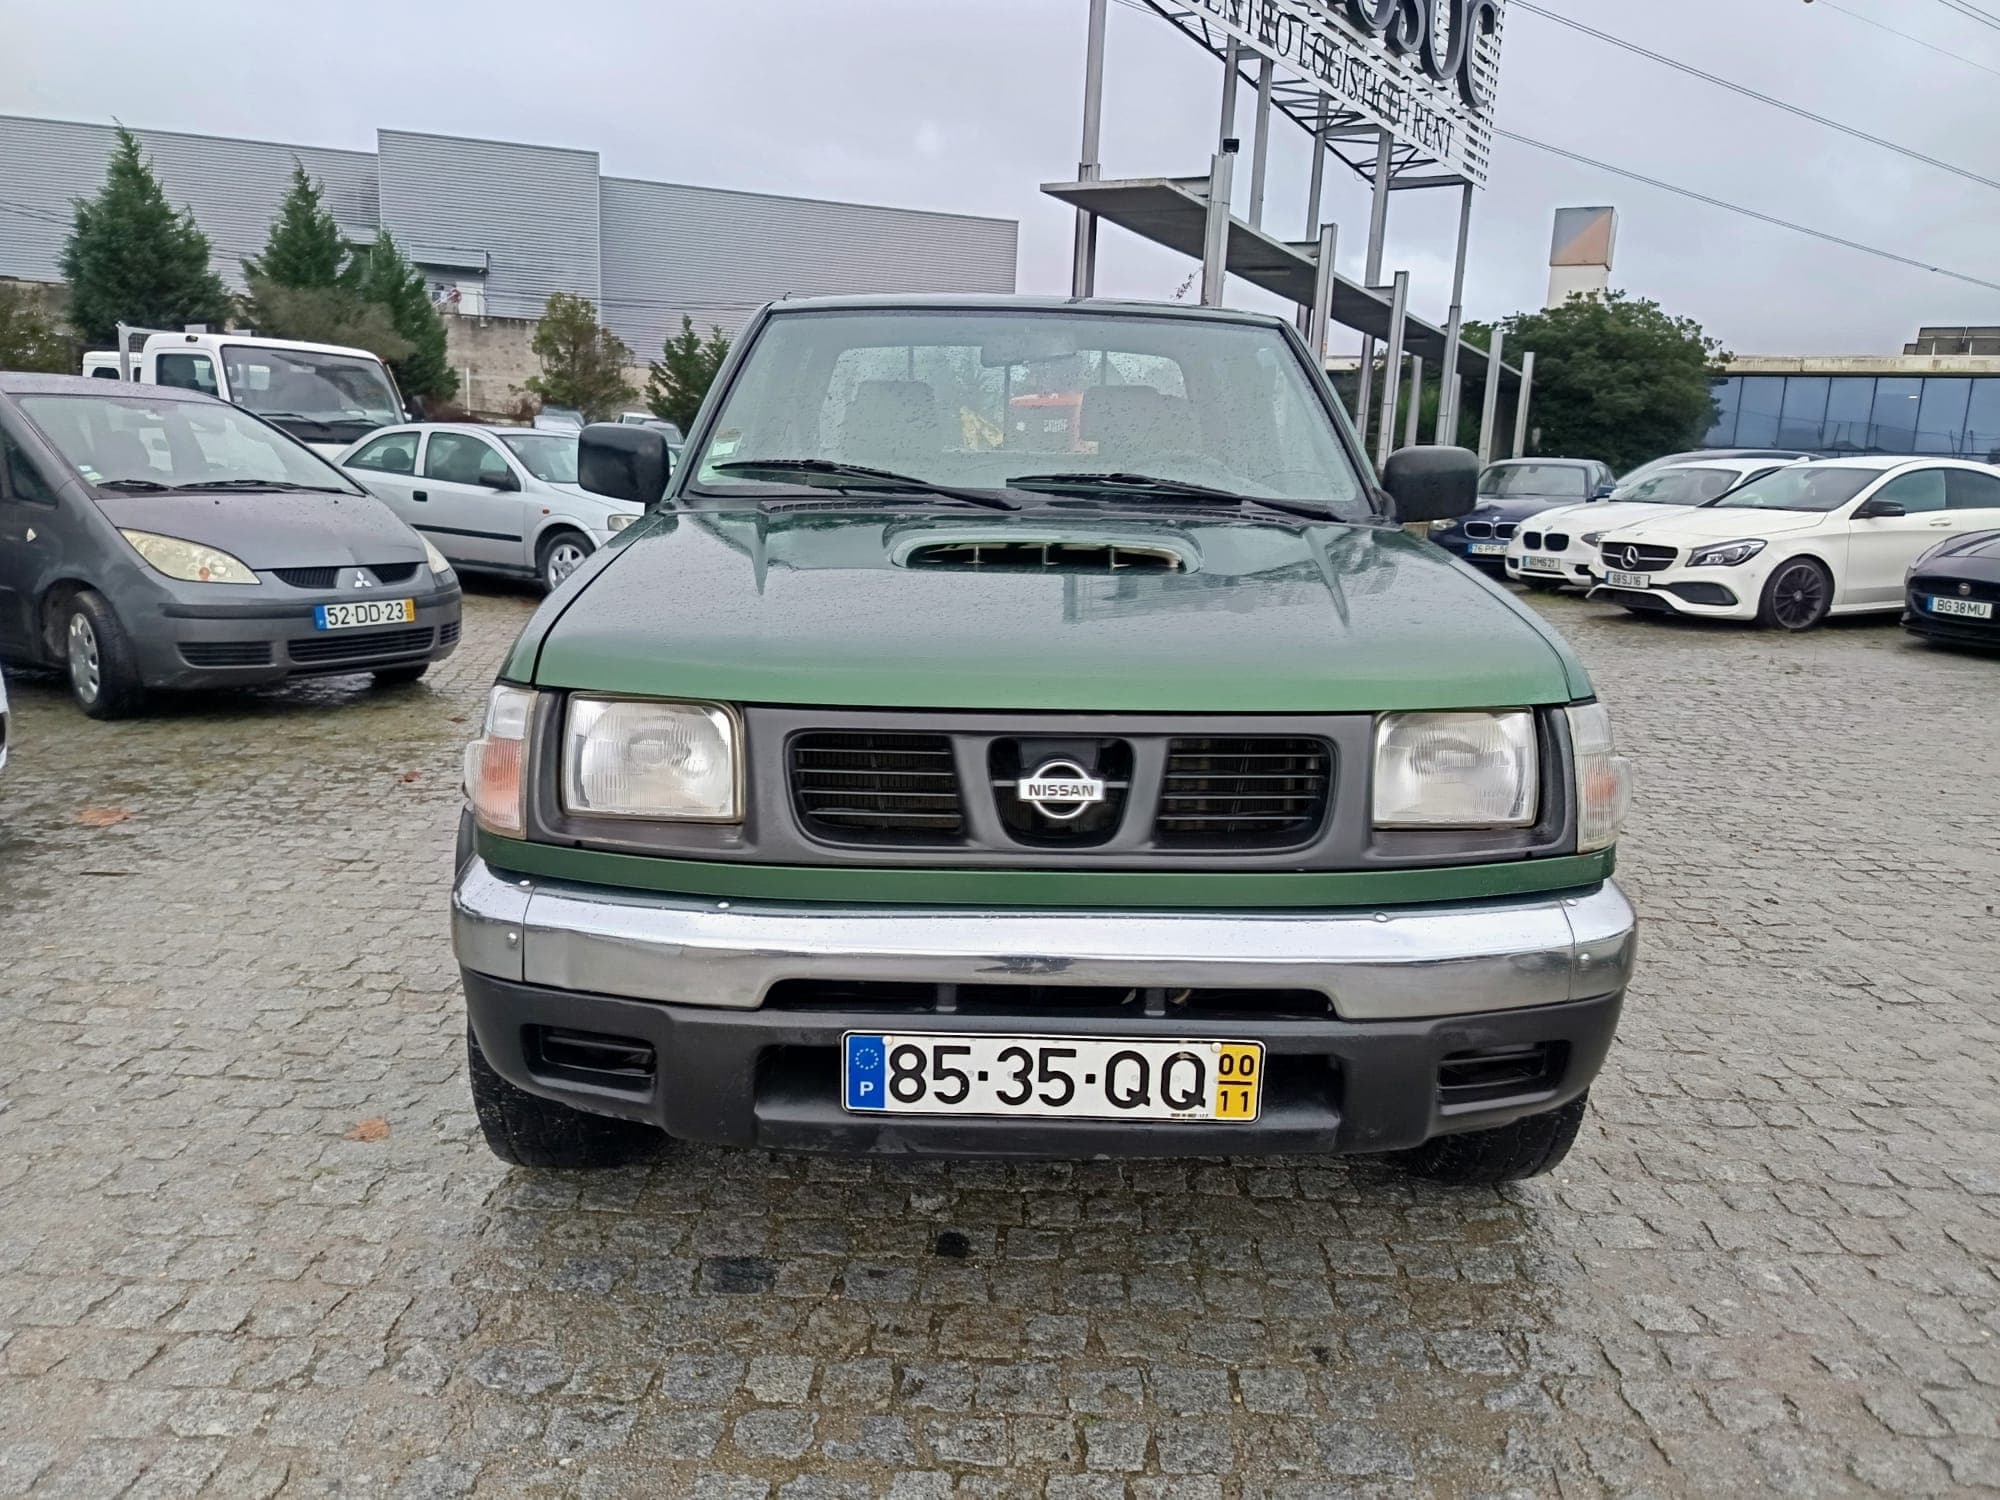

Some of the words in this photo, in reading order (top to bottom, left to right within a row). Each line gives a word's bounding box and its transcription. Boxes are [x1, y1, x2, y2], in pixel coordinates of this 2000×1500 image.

[1028, 784, 1094, 797] NISSAN
[1218, 1053, 1254, 1077] 00
[859, 1081, 874, 1097] P
[1220, 1090, 1248, 1112] 11
